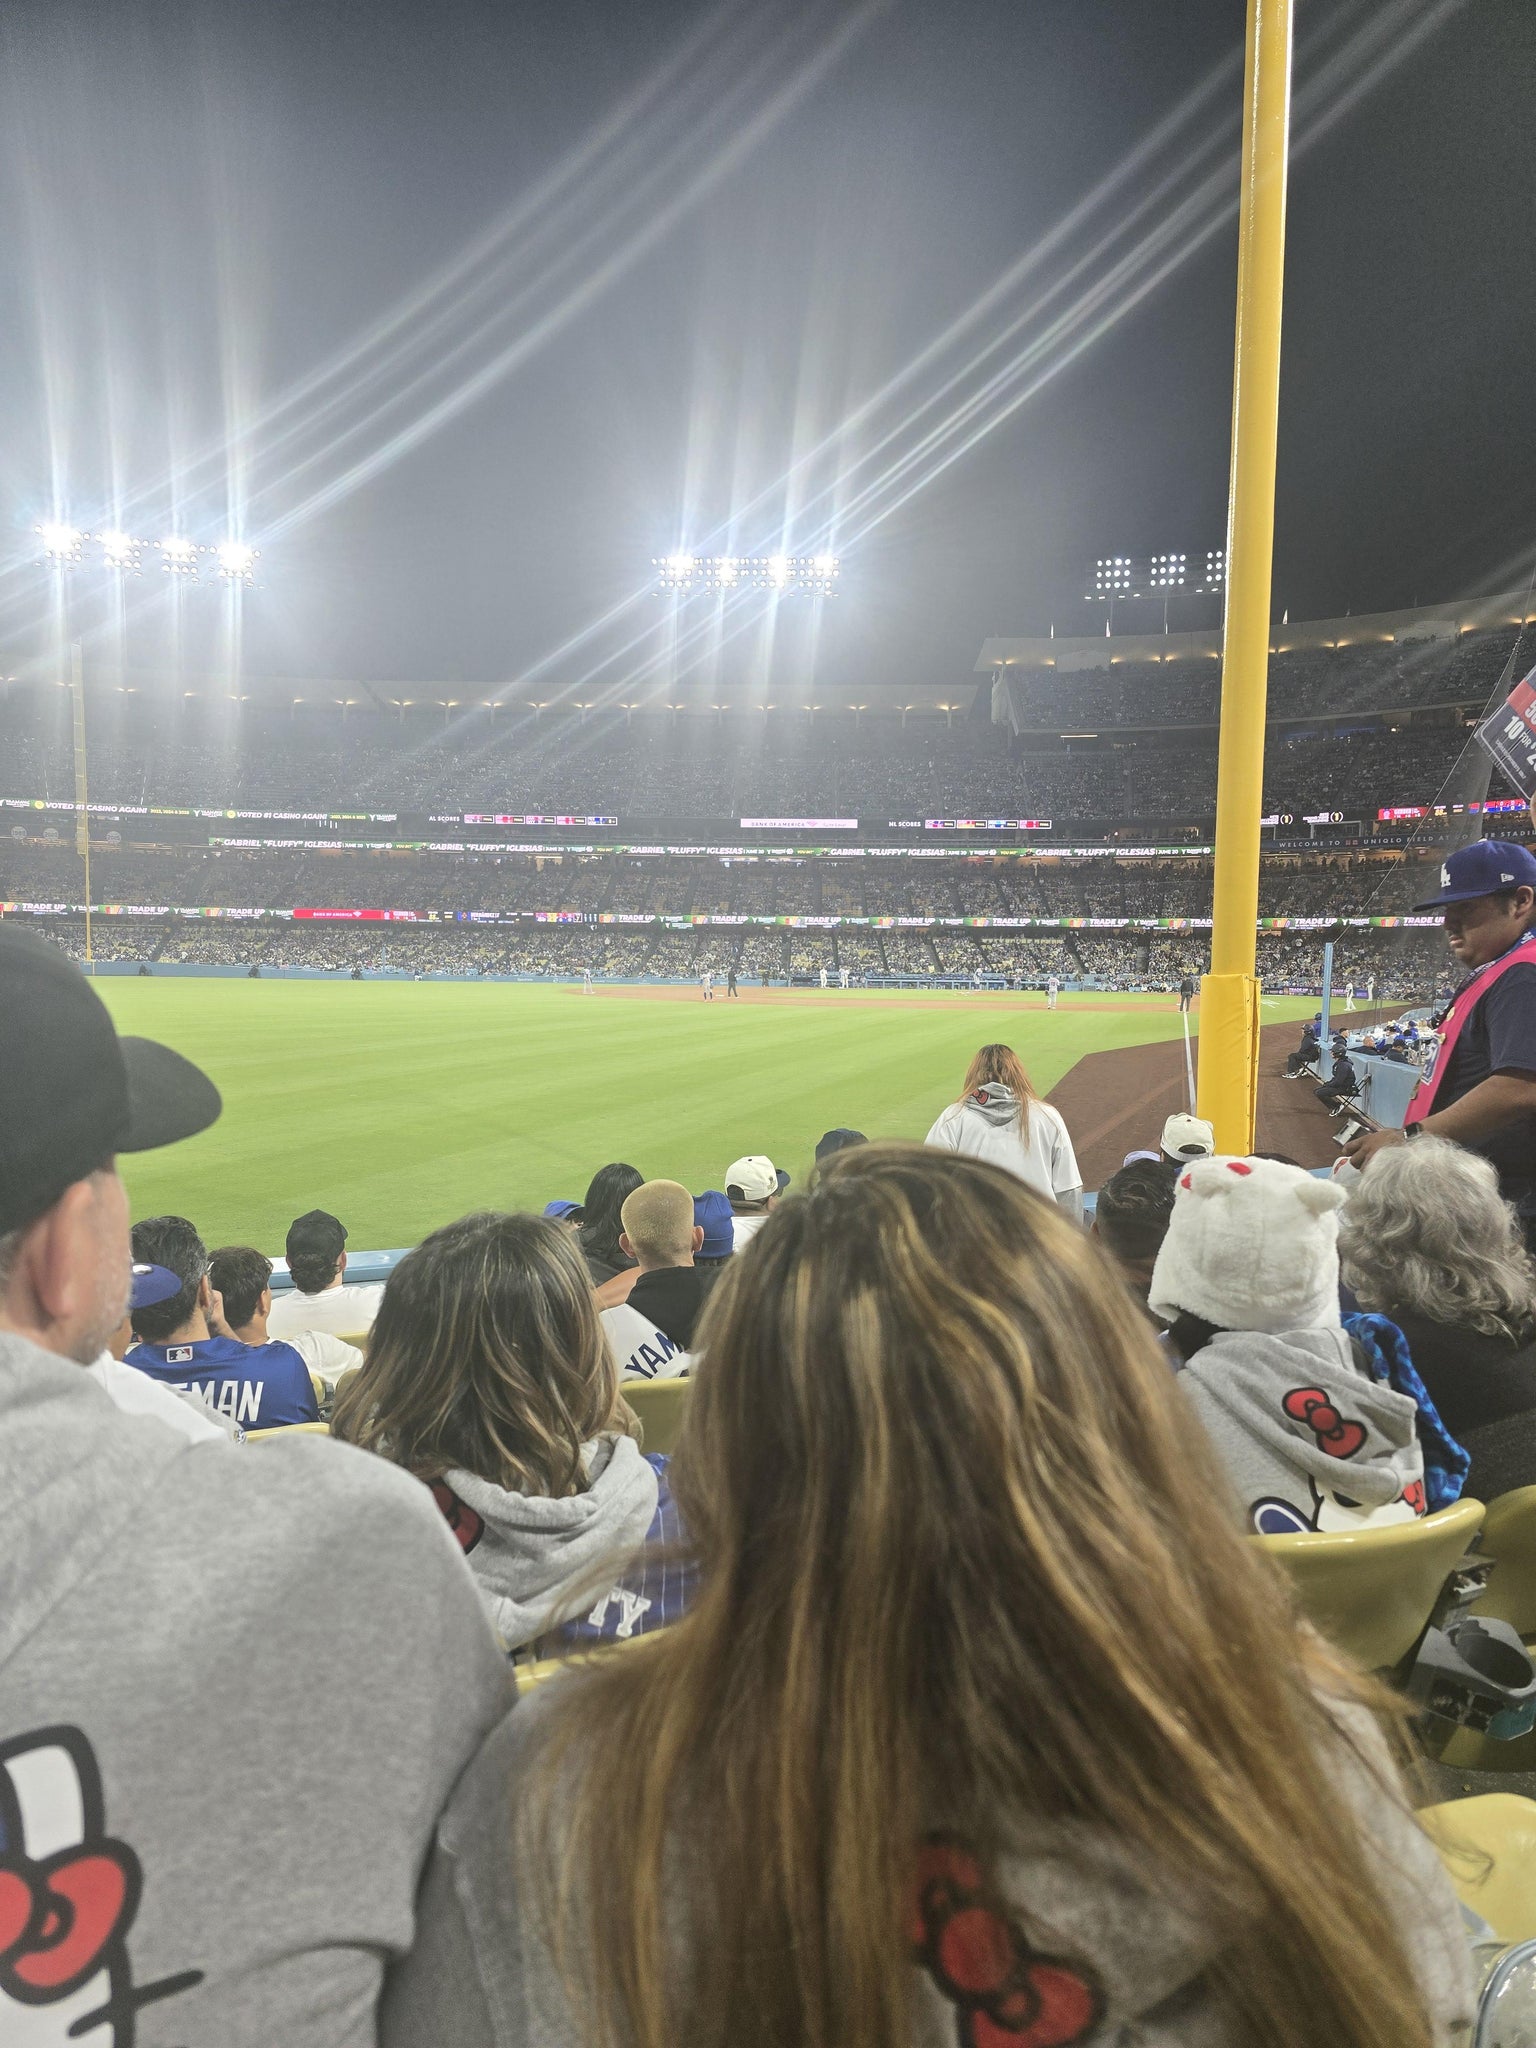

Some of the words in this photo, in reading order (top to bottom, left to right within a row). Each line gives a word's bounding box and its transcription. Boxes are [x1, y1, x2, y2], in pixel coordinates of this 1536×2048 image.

[1503, 716, 1525, 740] 10
[1518, 731, 1532, 748] FOR
[45, 801, 75, 810] VOTED
[86, 804, 118, 813] CASINO
[118, 806, 148, 814] AGAIN!
[237, 811, 262, 819] VOTED
[263, 811, 272, 819] #1
[273, 812, 301, 820] CASINO
[301, 813, 328, 821] AGAIN!
[437, 815, 460, 823] SCORES
[224, 838, 262, 847] GABRIEL
[304, 841, 342, 849] IGLESIAS
[429, 843, 465, 851] GABRIEL
[506, 844, 543, 852] IGLESIAS
[630, 846, 665, 854] GABRIEL
[706, 847, 743, 855] IGLESIAS
[831, 848, 866, 856] GABRIEL
[908, 848, 946, 856] IGLESIAS
[1036, 848, 1072, 856] GABRIEL
[1115, 847, 1156, 856] IGLESIAS
[22, 902, 54, 911] TRADE
[55, 903, 67, 911] UP
[127, 905, 157, 913] TRADE
[226, 907, 254, 915] TRADE
[619, 914, 646, 922] TRADE
[646, 914, 657, 922] UP
[804, 916, 830, 924] TRADE
[831, 916, 842, 924] UP
[898, 917, 924, 925] TRADE
[924, 917, 936, 925] UP
[992, 917, 1018, 925] TRADE
[1019, 917, 1032, 925] UP
[1089, 918, 1116, 926] TRADE
[1116, 918, 1130, 926] UP
[1190, 918, 1213, 926] TRAD
[1294, 917, 1323, 925] TRADE
[1324, 917, 1338, 925] UP
[1403, 916, 1431, 924] TRADE
[176, 1380, 264, 1422] MAN
